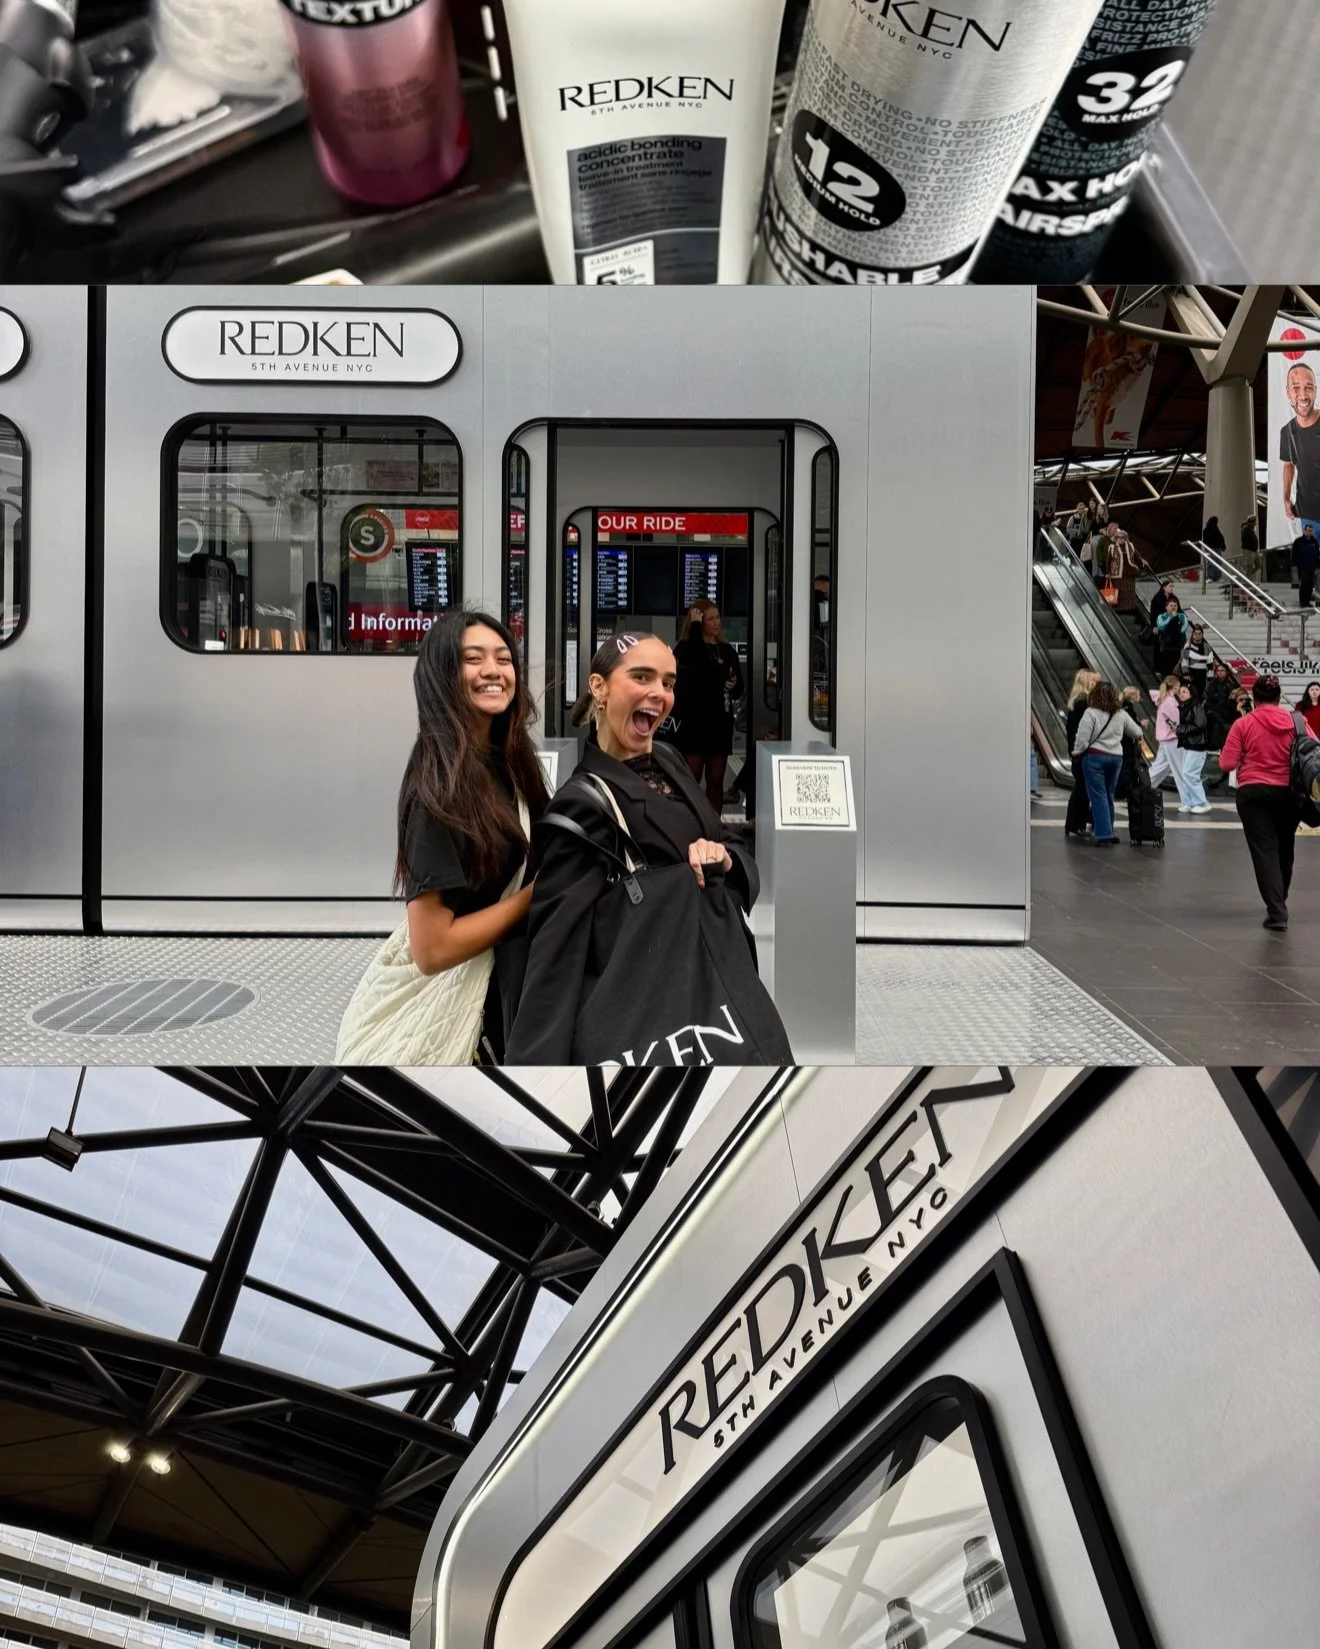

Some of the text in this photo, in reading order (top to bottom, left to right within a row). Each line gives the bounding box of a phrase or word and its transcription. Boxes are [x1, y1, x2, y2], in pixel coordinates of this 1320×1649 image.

[1100, 4, 1199, 21] ROTECTION
[864, 0, 1012, 51] KEN
[1090, 30, 1144, 43] FRIZZ
[1094, 19, 1181, 33] SISTANCE
[917, 43, 952, 60] NYC
[558, 76, 734, 111] REDKEN
[1077, 60, 1186, 114] 32
[621, 101, 671, 110] AVENUE
[850, 93, 928, 136] CONTROL
[851, 81, 913, 121] DRYING
[924, 116, 952, 128] NO
[1082, 114, 1120, 124] MAX
[842, 121, 918, 163] CONTROL
[843, 110, 903, 150] DRYING
[914, 146, 940, 157] NO
[865, 115, 964, 149] MOVEMENT
[577, 137, 703, 162] acidic bonding
[578, 150, 685, 174] concentrate
[626, 159, 684, 173] treatment
[804, 131, 881, 214] 12
[838, 201, 881, 225] HOLD
[218, 320, 405, 358] REDKEN
[251, 362, 373, 373] 5TH AVENUE NYC
[598, 515, 686, 531] OUR RIDE
[361, 525, 375, 546] S
[789, 806, 841, 817] REDKEN
[658, 1066, 1016, 1475] REDKEN
[713, 1186, 948, 1448] 5TH AVENUE NYC
